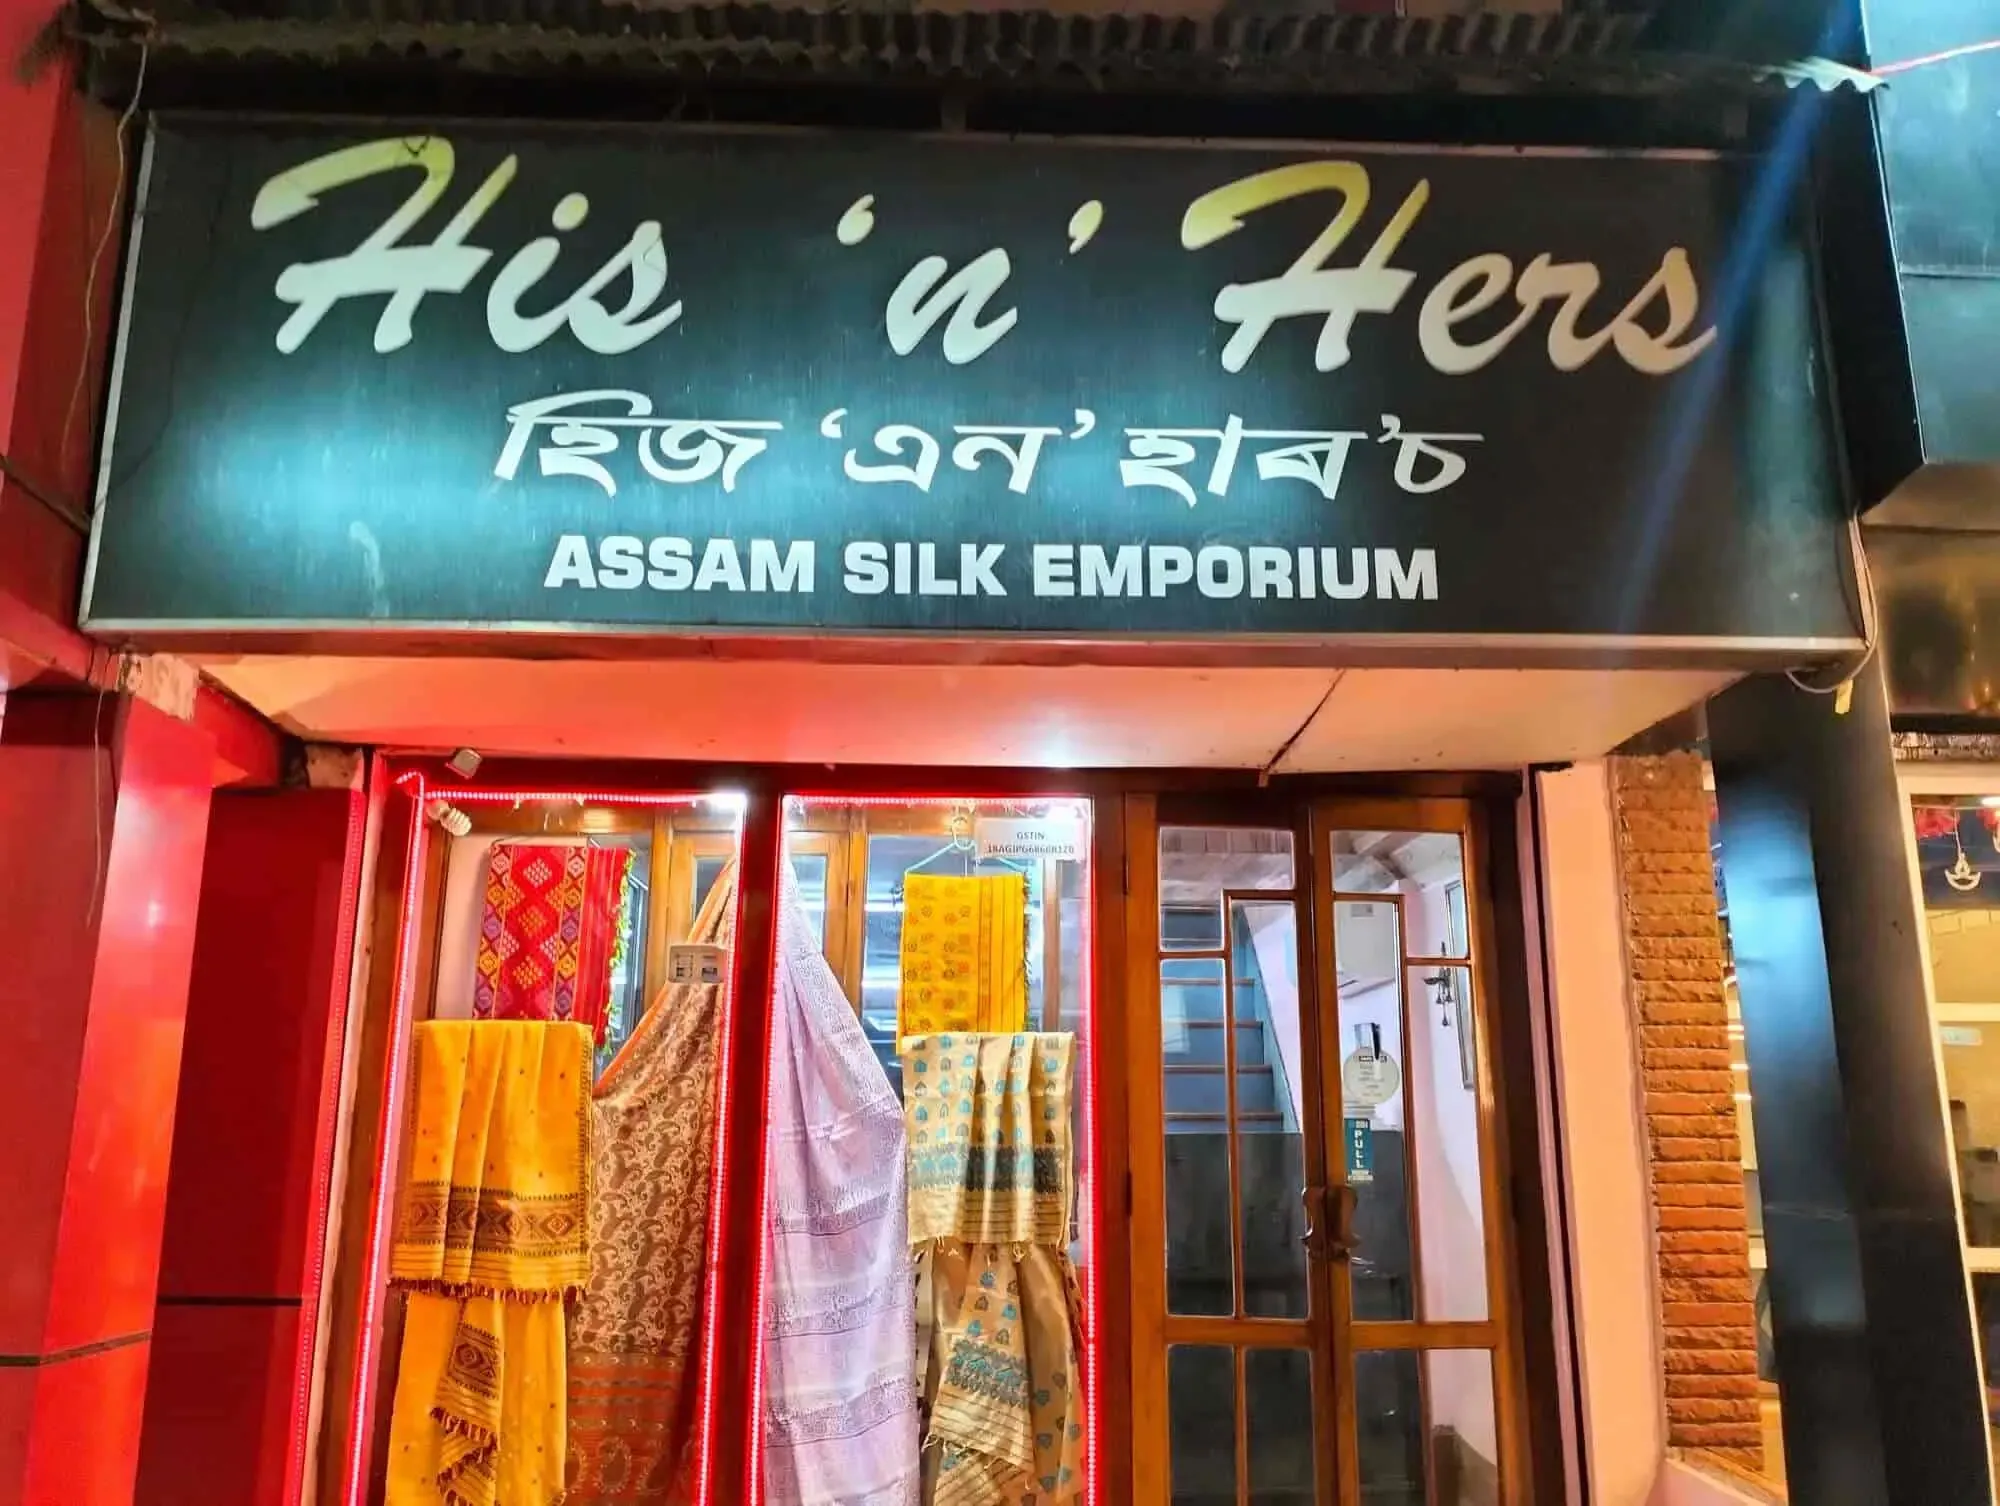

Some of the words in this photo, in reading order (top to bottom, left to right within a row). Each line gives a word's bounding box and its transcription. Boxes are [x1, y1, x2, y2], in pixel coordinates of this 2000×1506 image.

[251, 137, 682, 354] His
[1181, 161, 1717, 374] Hers
[494, 390, 783, 497] হিজ
[544, 535, 815, 593] ASSAM
[843, 541, 1007, 596] SILK
[1033, 544, 1438, 600] EMPORIUM
[1354, 1129, 1364, 1169] PULL
